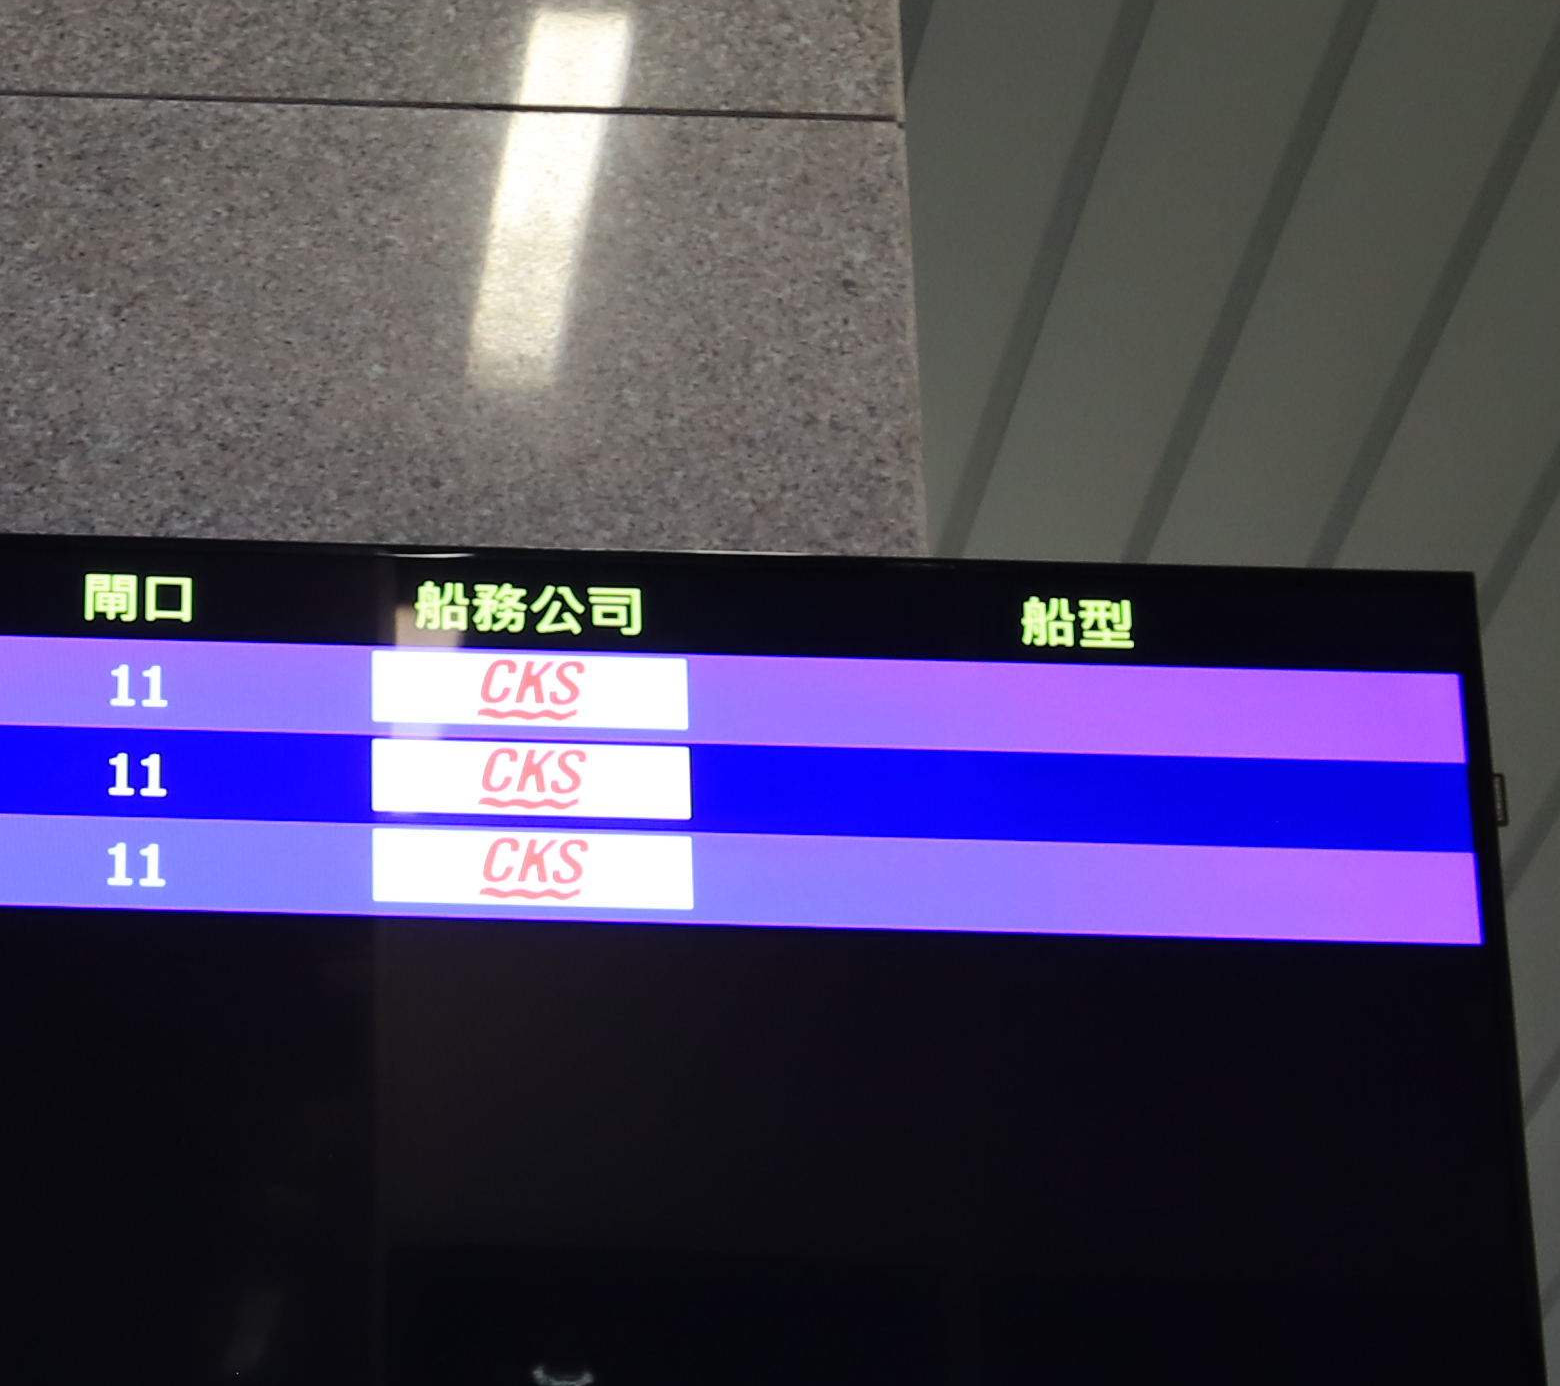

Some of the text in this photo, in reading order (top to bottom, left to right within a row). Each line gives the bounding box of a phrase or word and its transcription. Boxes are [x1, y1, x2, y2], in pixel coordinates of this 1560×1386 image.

[84, 573, 193, 623] 閘口
[413, 580, 642, 636] 船務公司
[1020, 595, 1135, 649] 船型
[109, 663, 169, 708] 11
[479, 658, 586, 706] CKS
[108, 752, 167, 798] 11
[480, 747, 587, 795] CKS
[106, 841, 167, 888] 11
[482, 837, 589, 885] CKS
